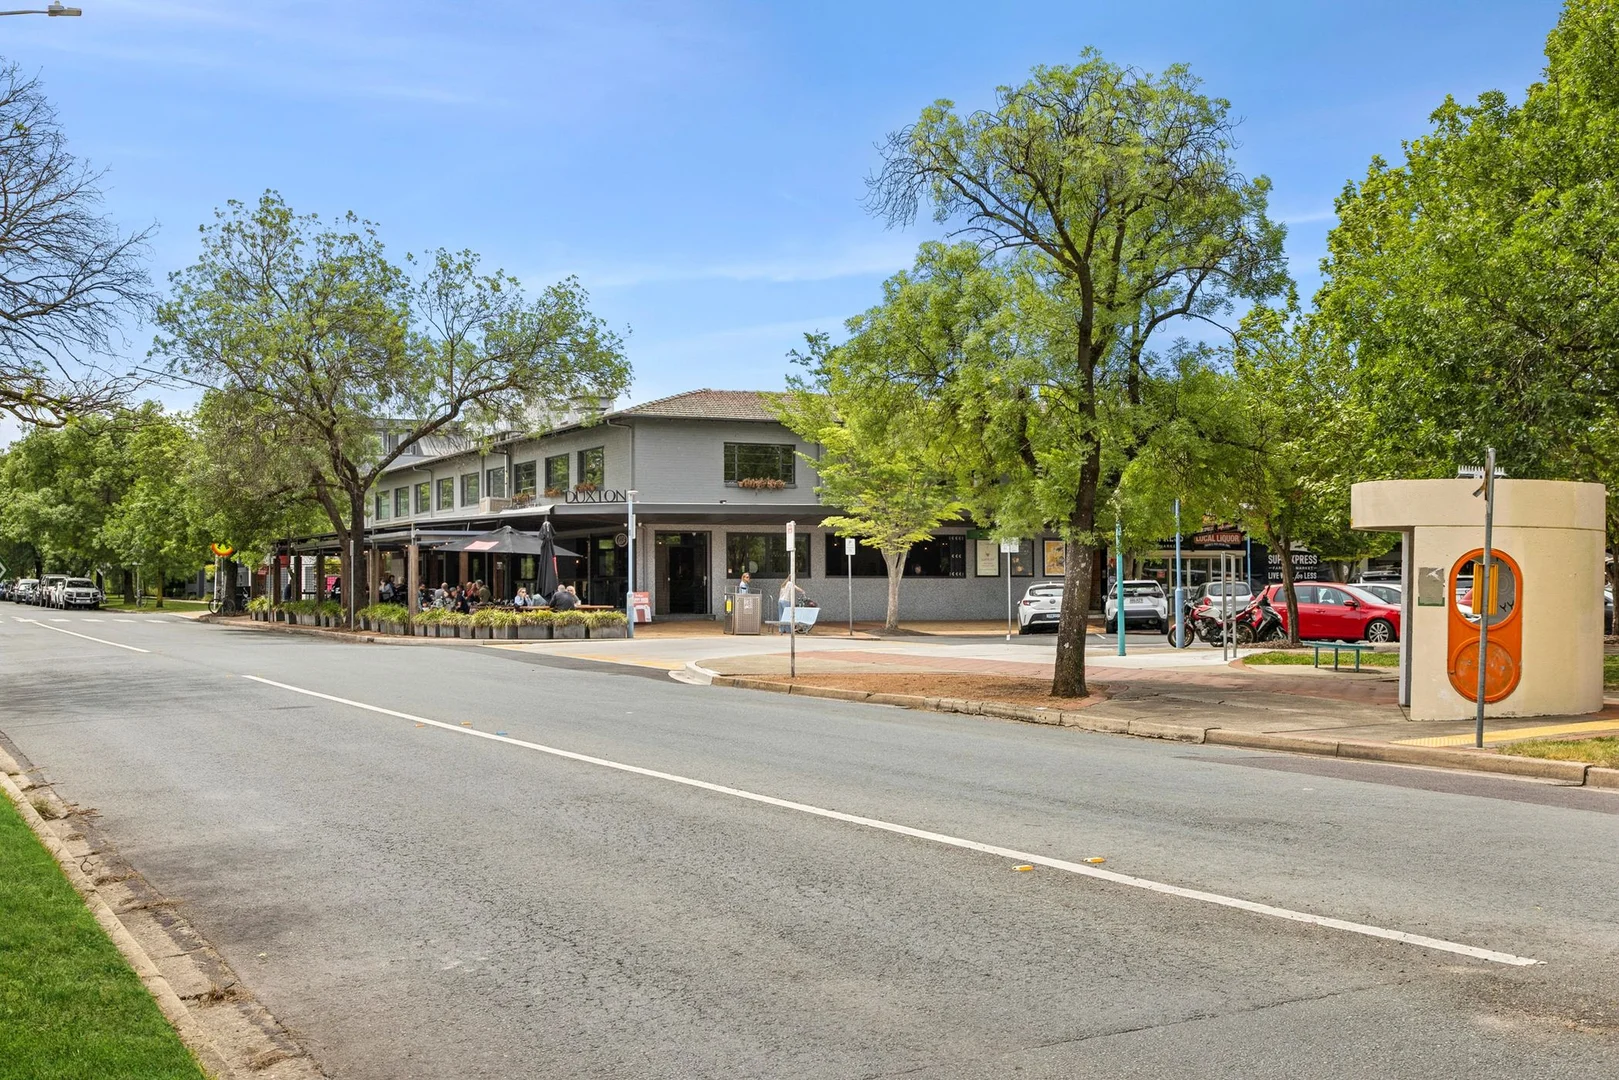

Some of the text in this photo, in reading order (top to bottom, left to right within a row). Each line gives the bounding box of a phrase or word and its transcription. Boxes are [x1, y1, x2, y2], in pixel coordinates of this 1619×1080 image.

[565, 489, 627, 504] DUXTON
[1195, 534, 1216, 543] LOCAL
[1216, 533, 1240, 543] LIQUOR
[1267, 571, 1280, 580] LIVE
[1303, 571, 1318, 580] LESS
